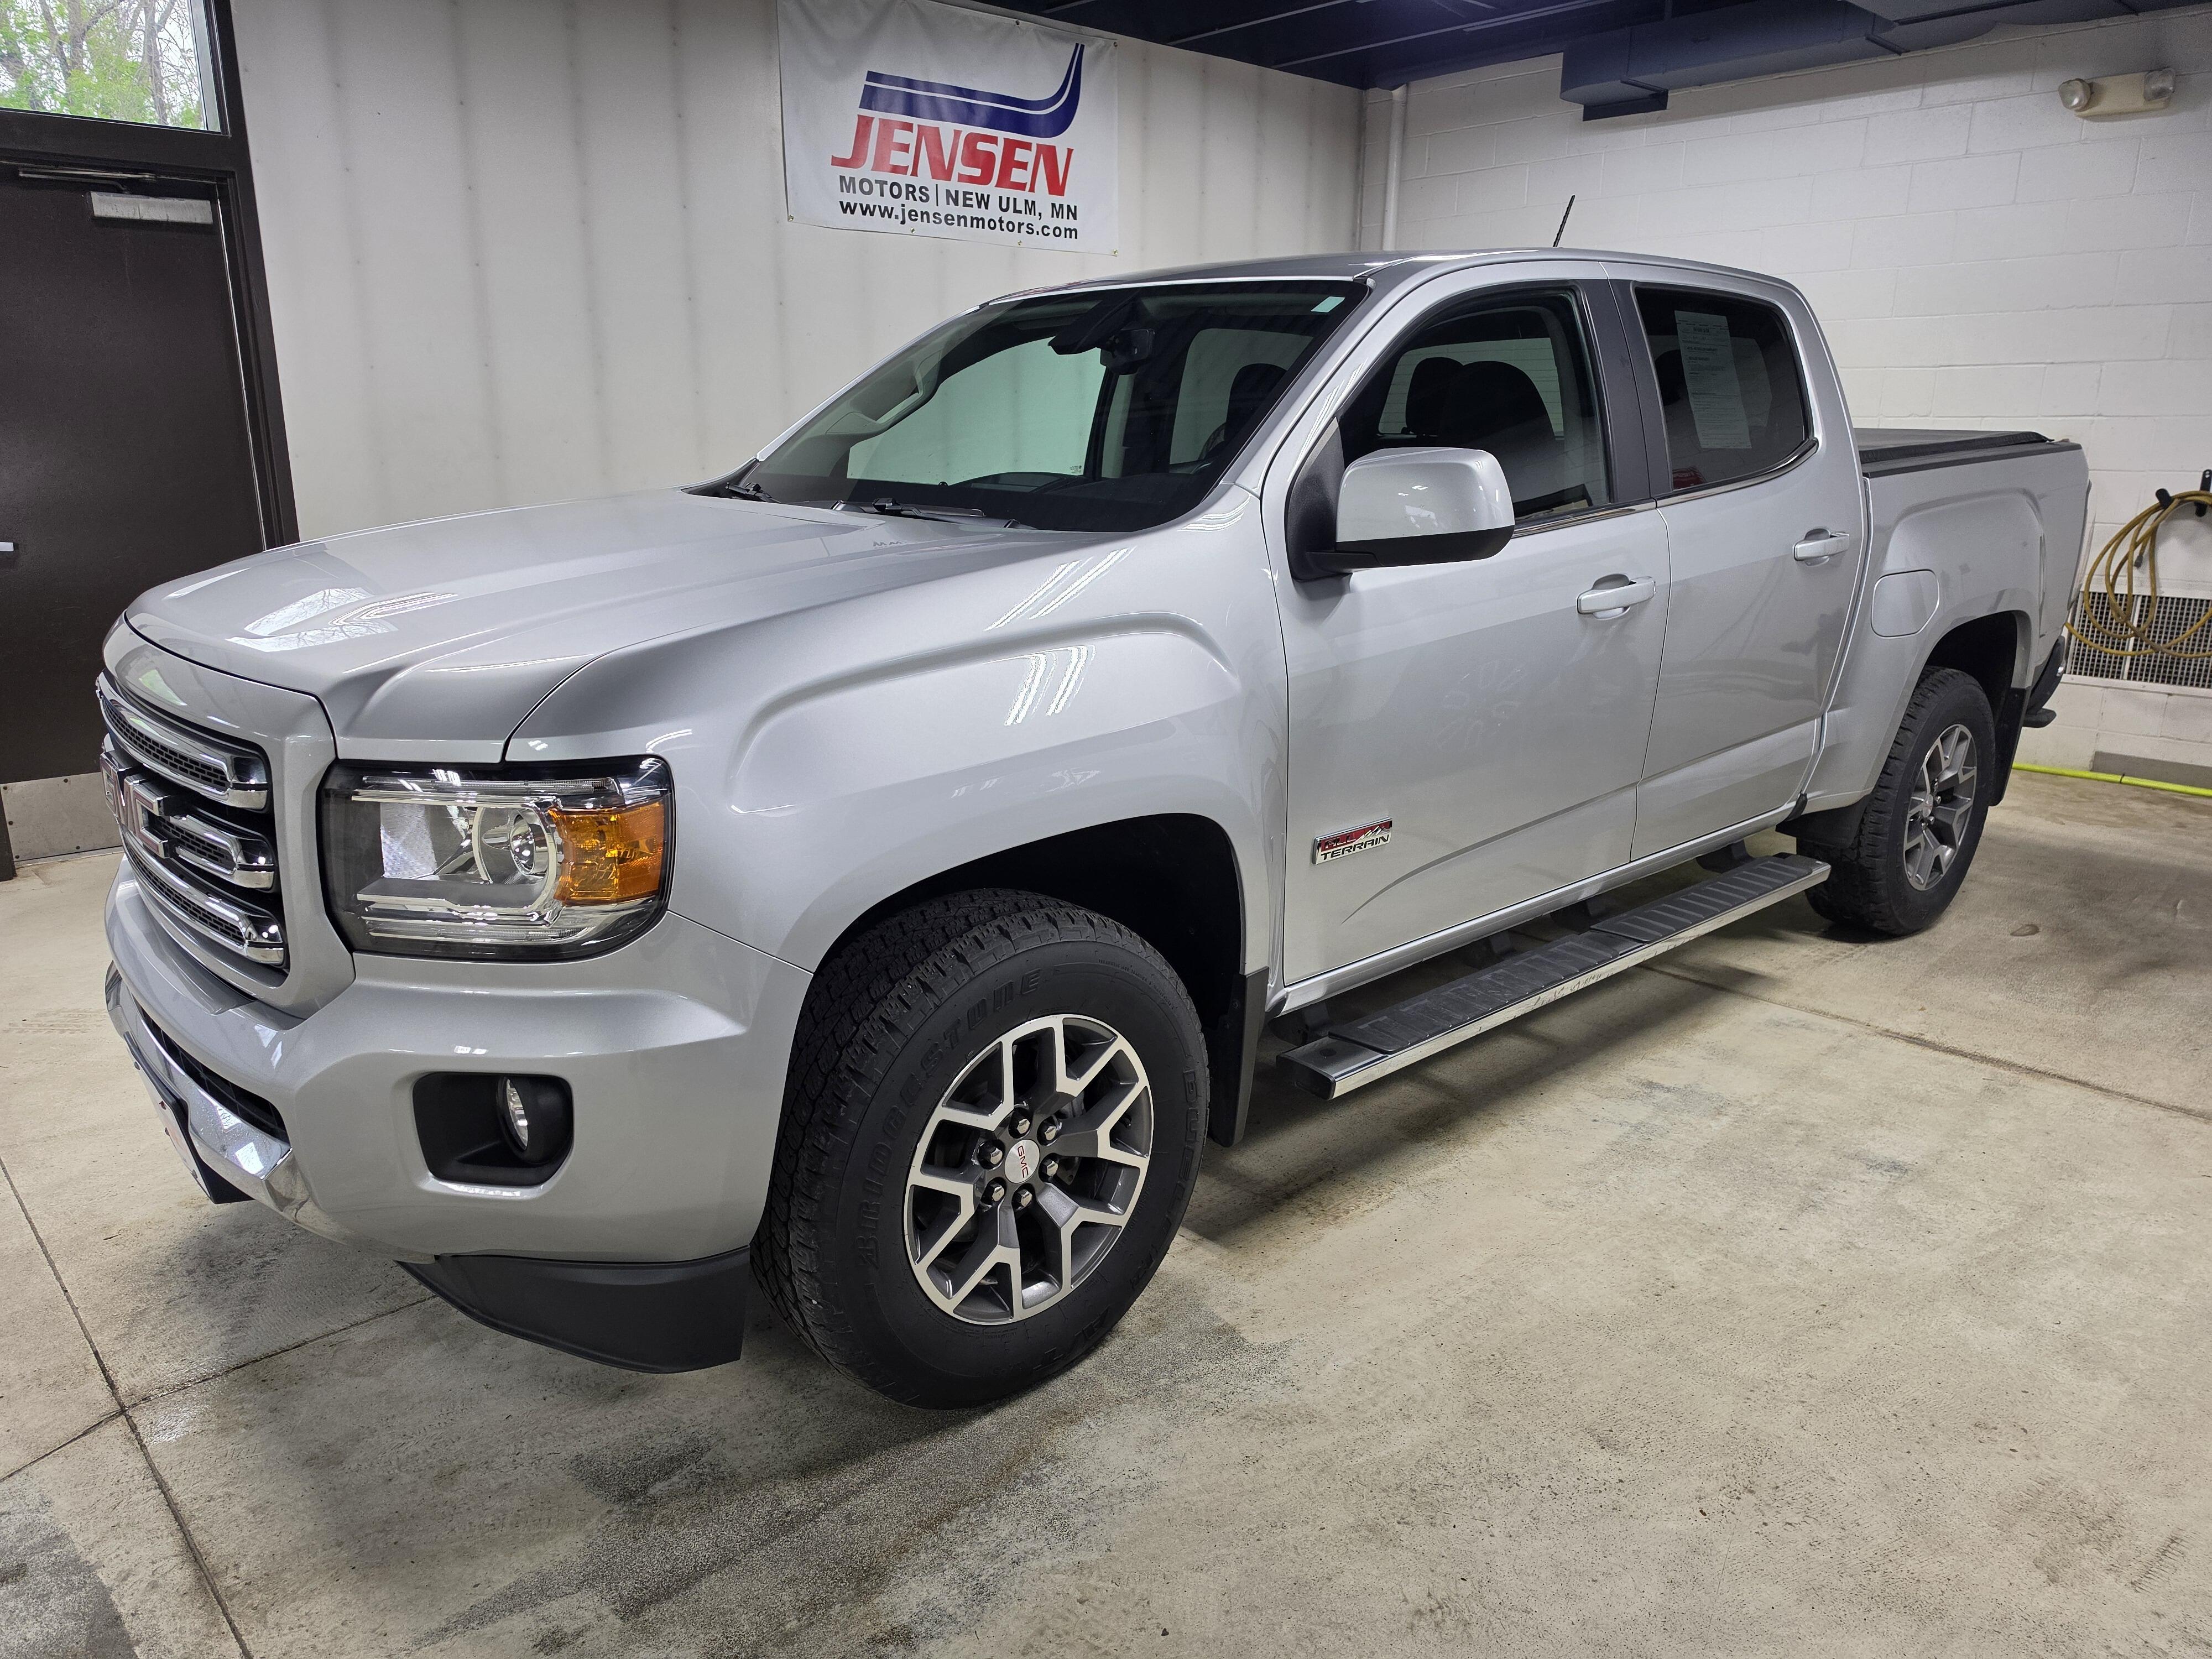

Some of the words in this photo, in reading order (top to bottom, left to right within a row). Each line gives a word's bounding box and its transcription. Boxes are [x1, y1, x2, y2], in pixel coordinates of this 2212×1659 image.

[831, 113, 1074, 197] JENSEN
[839, 175, 930, 203] MOTORS
[946, 189, 990, 210] NEW
[998, 196, 1042, 220] ULM,
[1051, 203, 1078, 221] MN
[839, 201, 1078, 239] www.jensenmotors.com
[1321, 834, 1390, 860] TERRAIN
[1325, 833, 1357, 849] ALL
[855, 968, 1042, 1269] BRIDGESTONE
[1017, 1145, 1029, 1178] GMC
